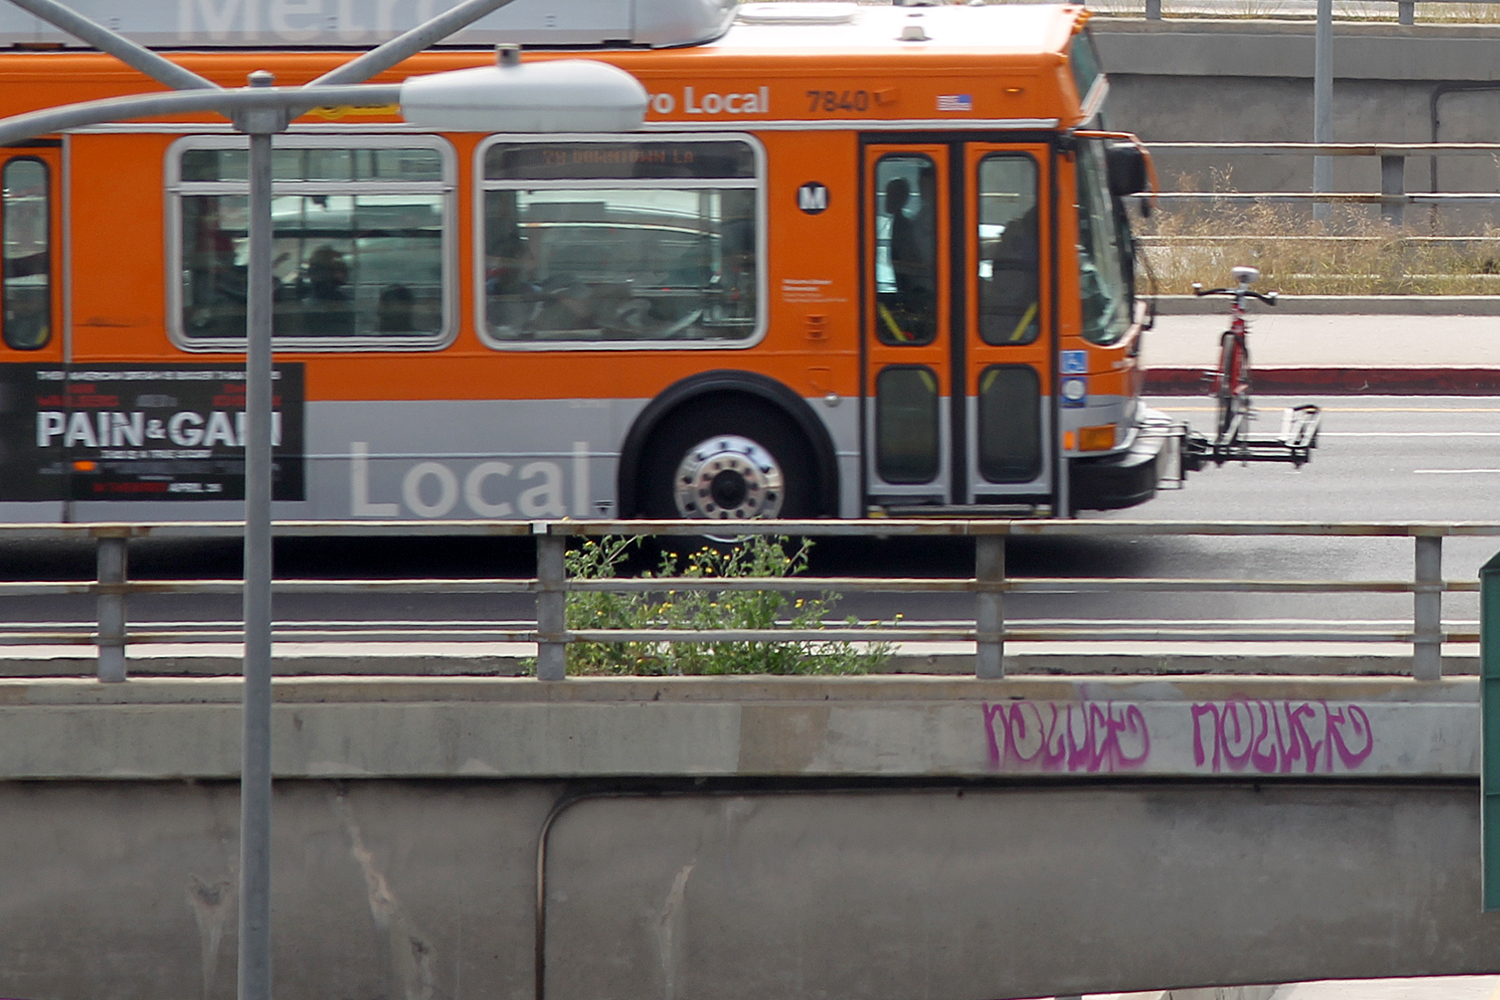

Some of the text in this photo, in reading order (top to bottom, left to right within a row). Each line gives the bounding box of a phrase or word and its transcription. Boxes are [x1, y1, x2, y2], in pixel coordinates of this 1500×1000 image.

[683, 85, 770, 114] Local
[806, 89, 869, 112] 7840
[351, 440, 590, 518] Local
